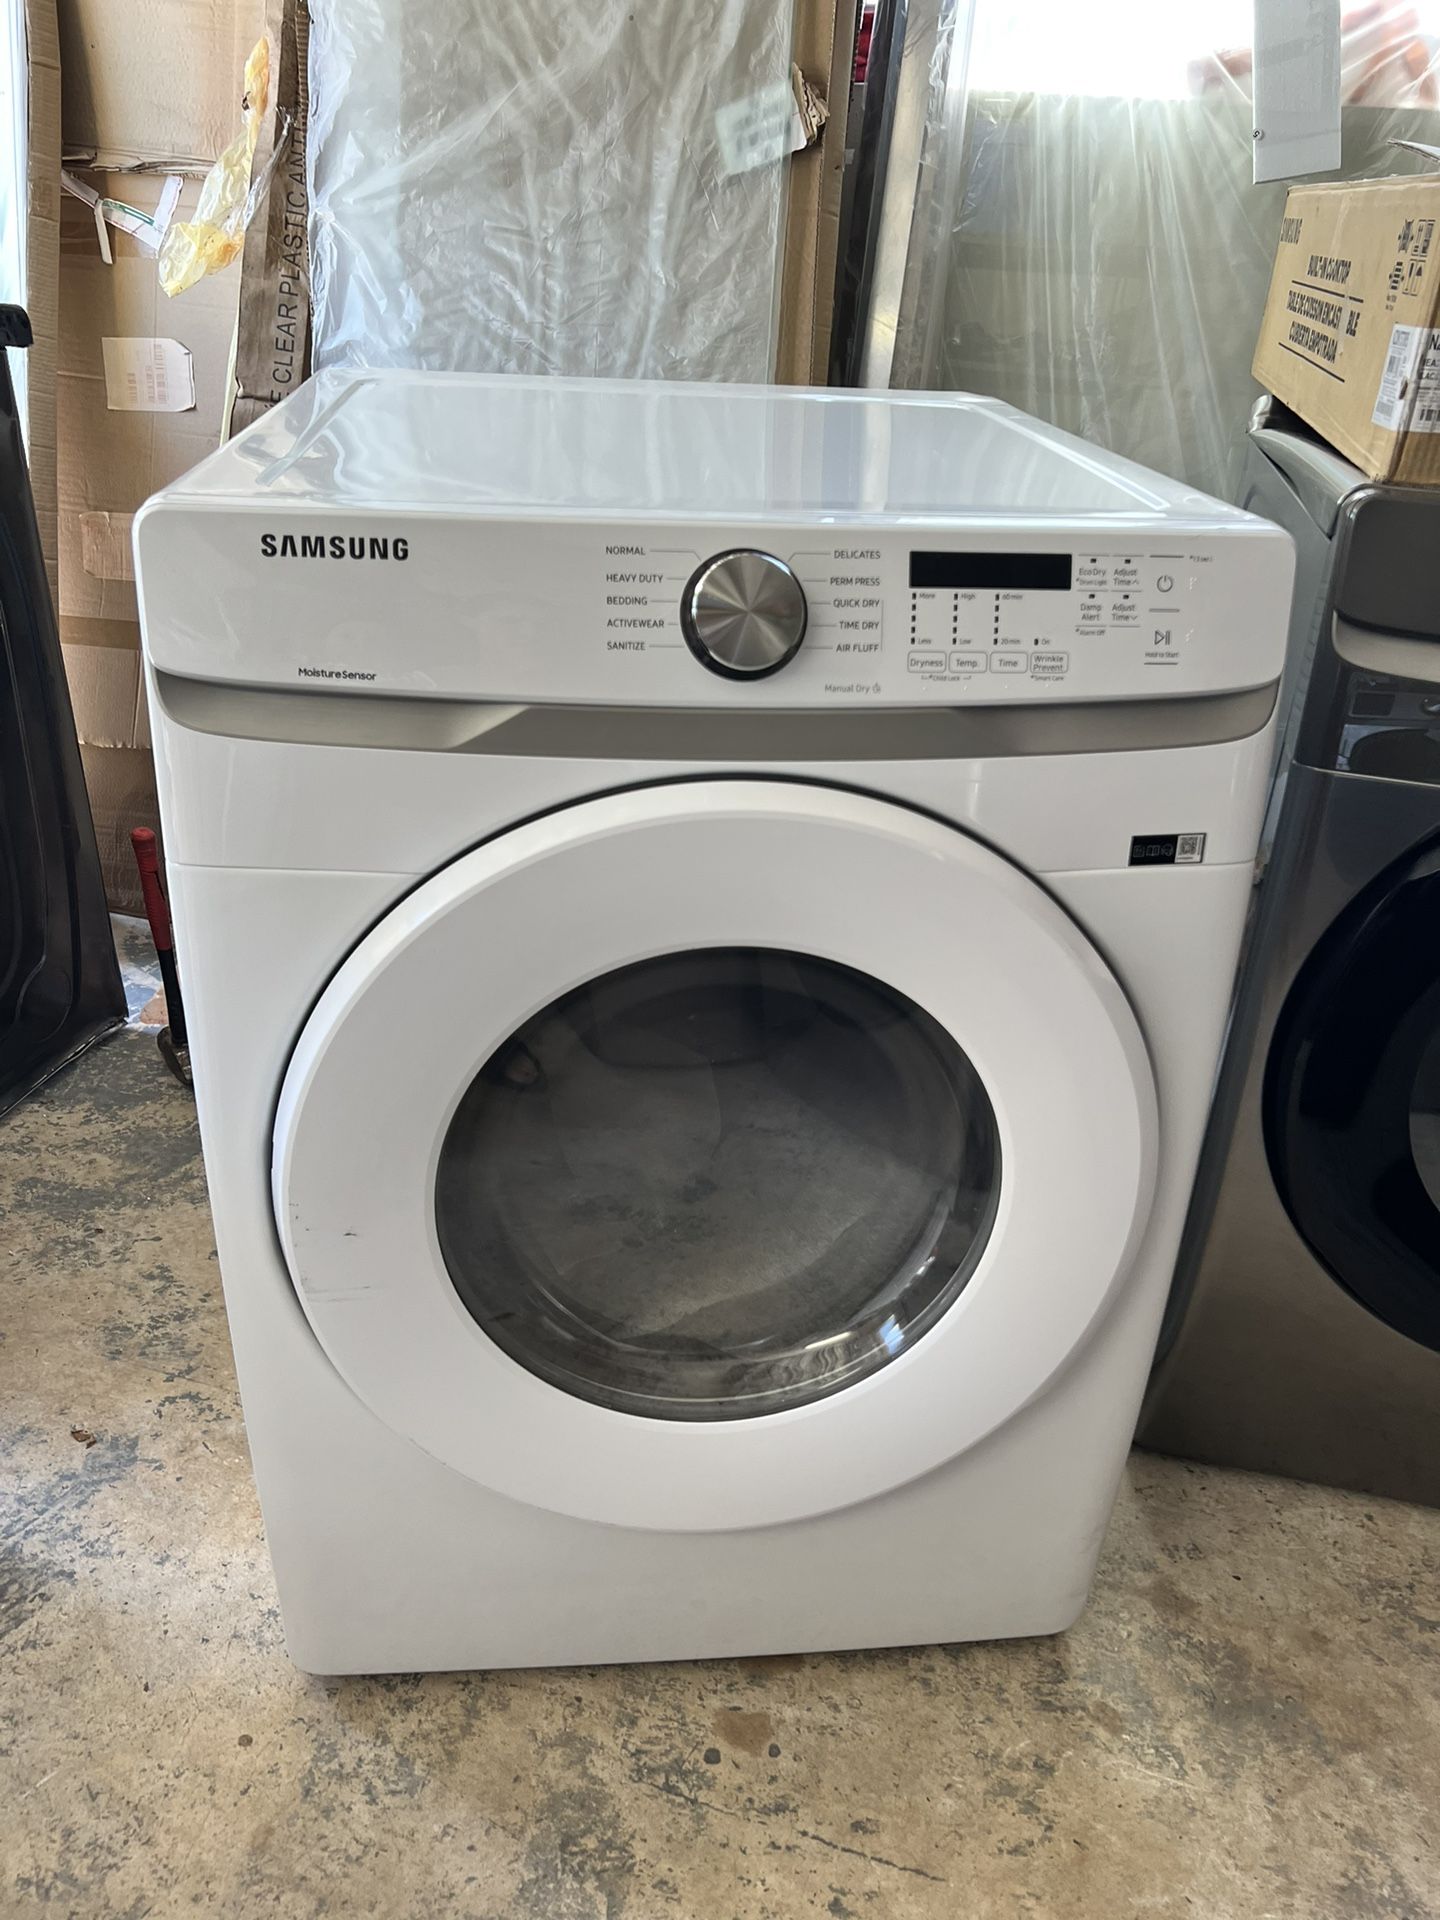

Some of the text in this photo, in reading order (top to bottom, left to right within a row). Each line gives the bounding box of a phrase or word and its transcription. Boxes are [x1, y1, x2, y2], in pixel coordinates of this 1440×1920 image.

[279, 191, 307, 297] PLASTIC
[272, 303, 298, 384] CLEAR
[261, 534, 409, 561] SAMSUNG
[605, 546, 646, 555] NORMAL
[834, 550, 881, 560] DELICATES
[606, 573, 663, 583] HEAVY DUTY
[1114, 569, 1138, 579] Adjust
[830, 577, 881, 587] PERM PRESS
[1113, 577, 1131, 586] Time
[606, 596, 648, 606] BEDDING
[833, 599, 880, 609] QUICK DRY
[1080, 604, 1102, 614] Damp
[1112, 604, 1136, 614] Adjust
[1081, 614, 1101, 622] Alert
[1112, 614, 1130, 622] Time
[607, 619, 665, 628] ACTIVEWEAR
[840, 621, 880, 631] TIME DRY
[607, 641, 646, 651] SANITIZE
[836, 644, 879, 653] AIR FLUFF
[910, 658, 943, 668] Dryness
[999, 659, 1018, 667] Time
[1034, 655, 1064, 665] Wrinkle
[1033, 664, 1064, 673] Prevent
[298, 667, 377, 681] Moisture Sensor
[824, 684, 871, 695] Manual Dry
